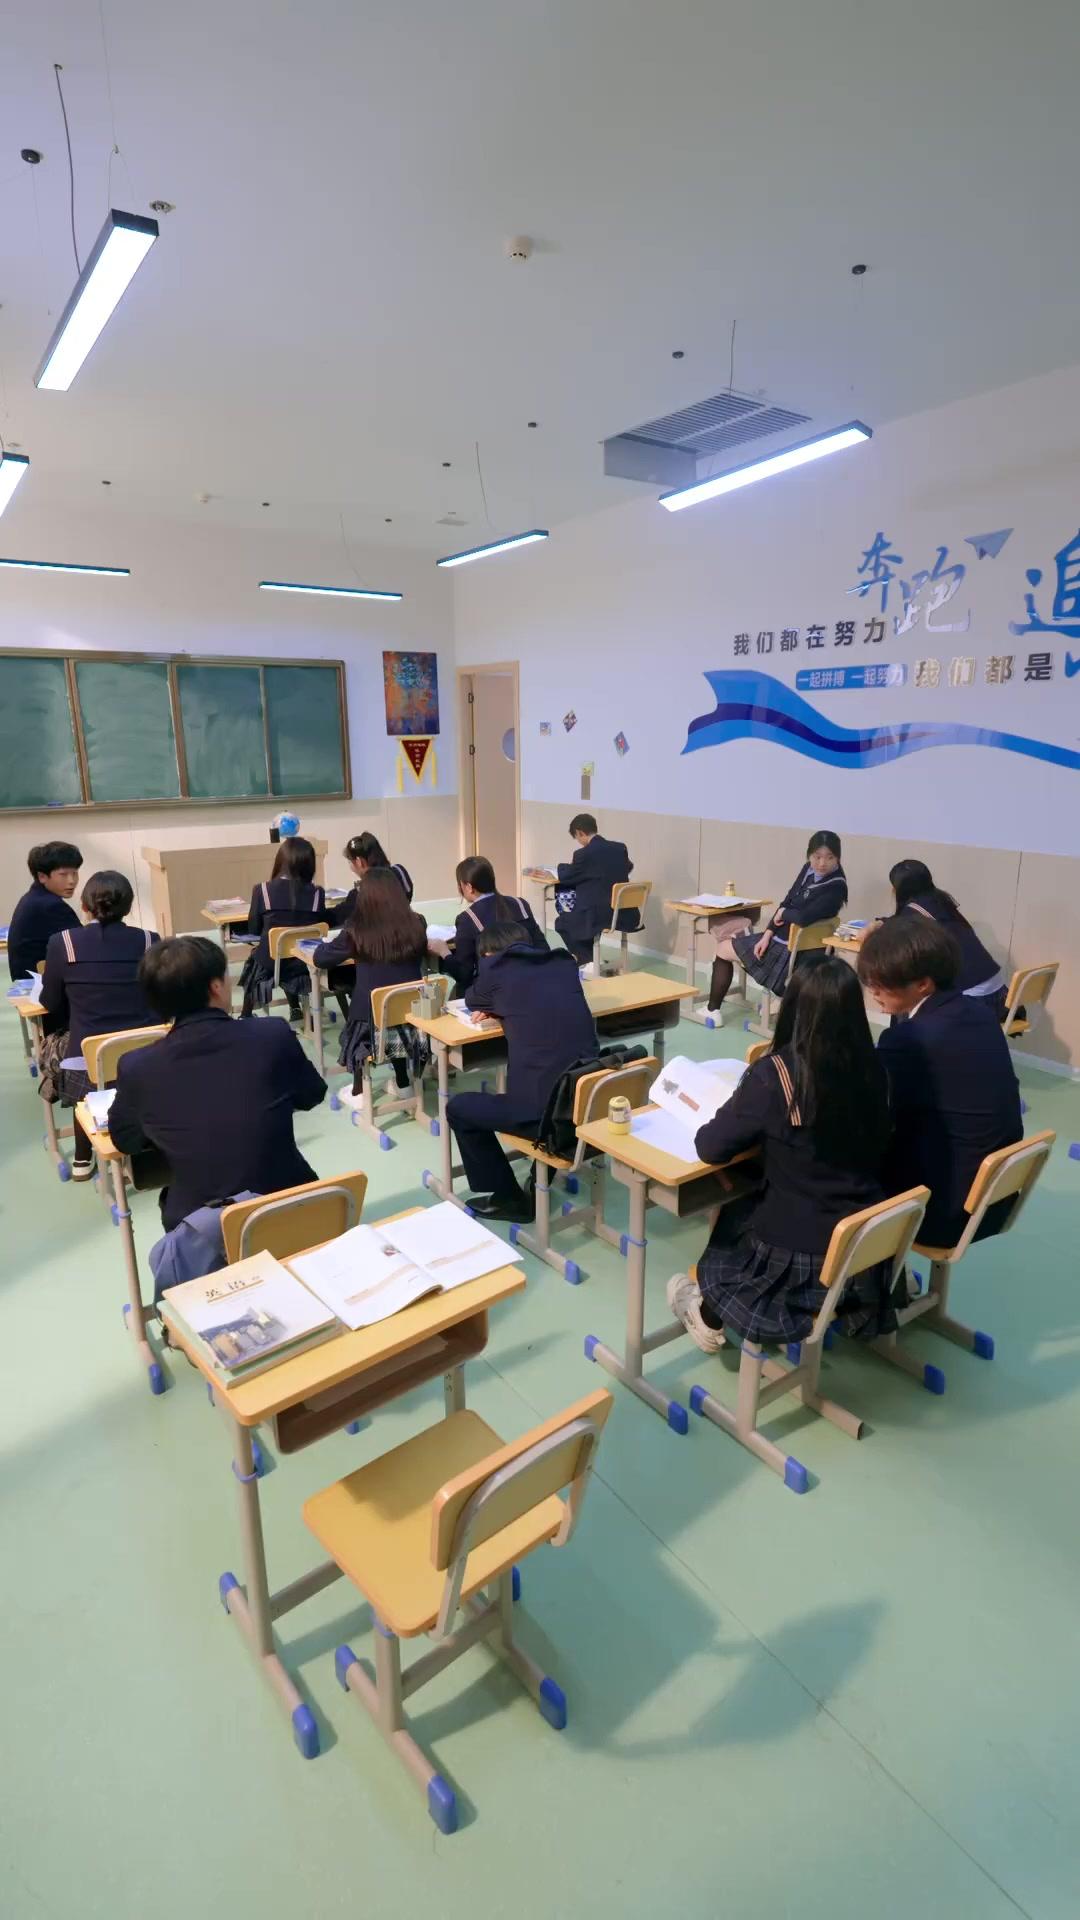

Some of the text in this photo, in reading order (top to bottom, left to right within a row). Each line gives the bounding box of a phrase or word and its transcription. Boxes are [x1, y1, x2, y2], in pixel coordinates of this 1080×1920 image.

[846, 532, 971, 635] 奔跑
[733, 617, 886, 656] 我们都在努力
[914, 652, 1053, 689] 我们都是
